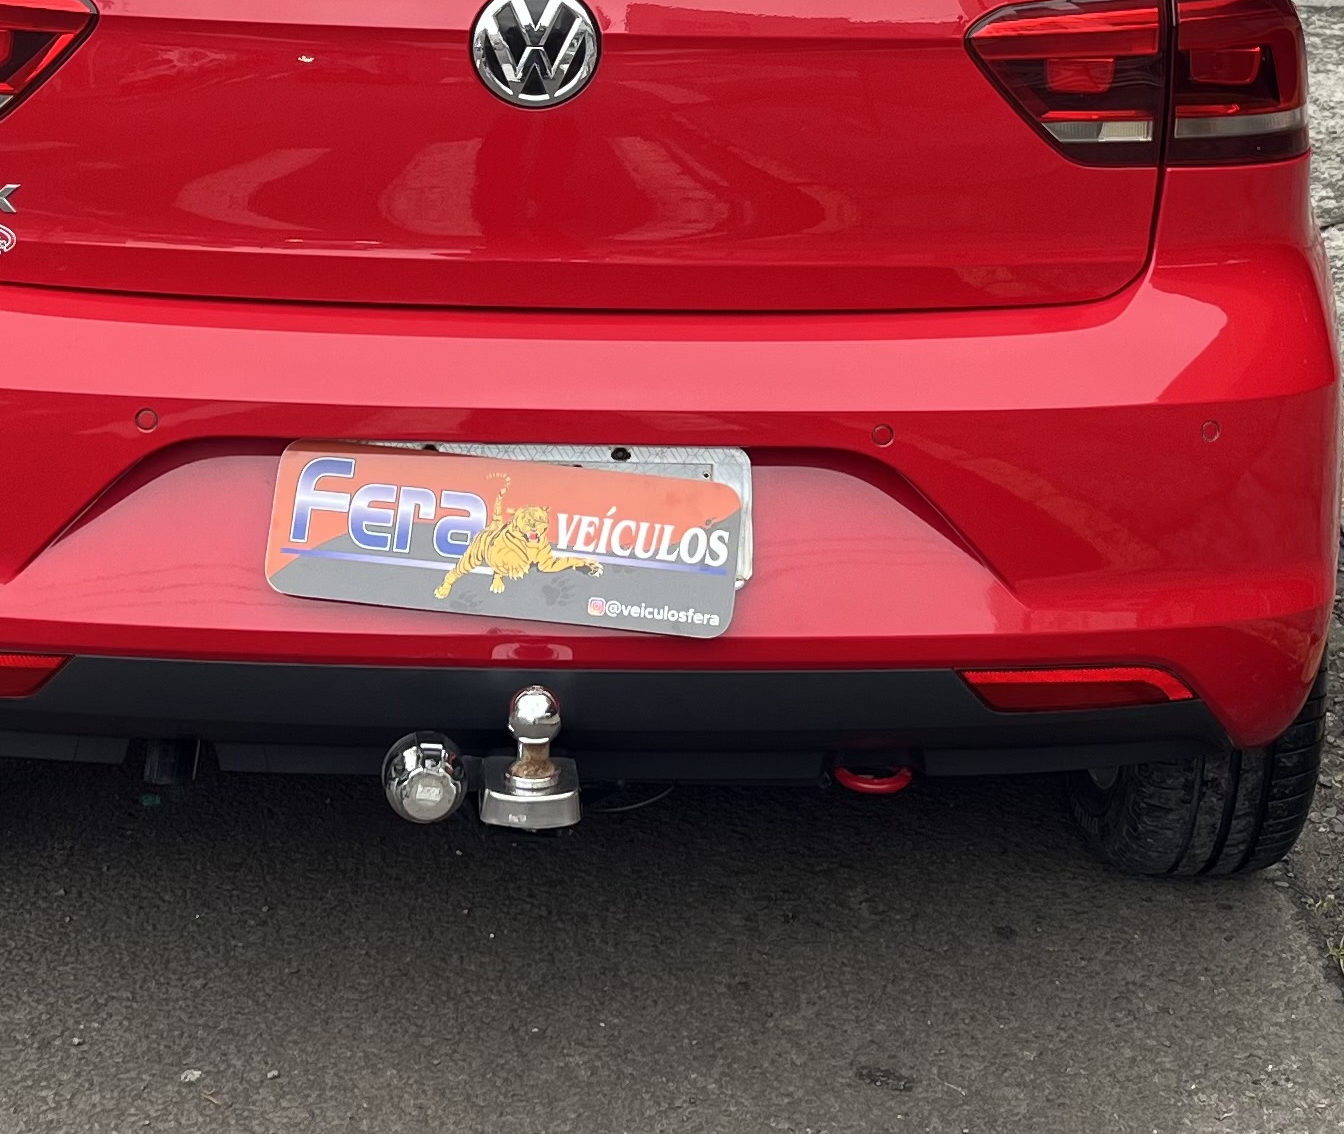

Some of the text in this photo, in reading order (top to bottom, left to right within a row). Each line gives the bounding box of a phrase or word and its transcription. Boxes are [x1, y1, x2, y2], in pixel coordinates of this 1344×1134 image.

[288, 457, 730, 567] Fera VEÍCULOS
[605, 600, 720, 628] @veiculosfera
